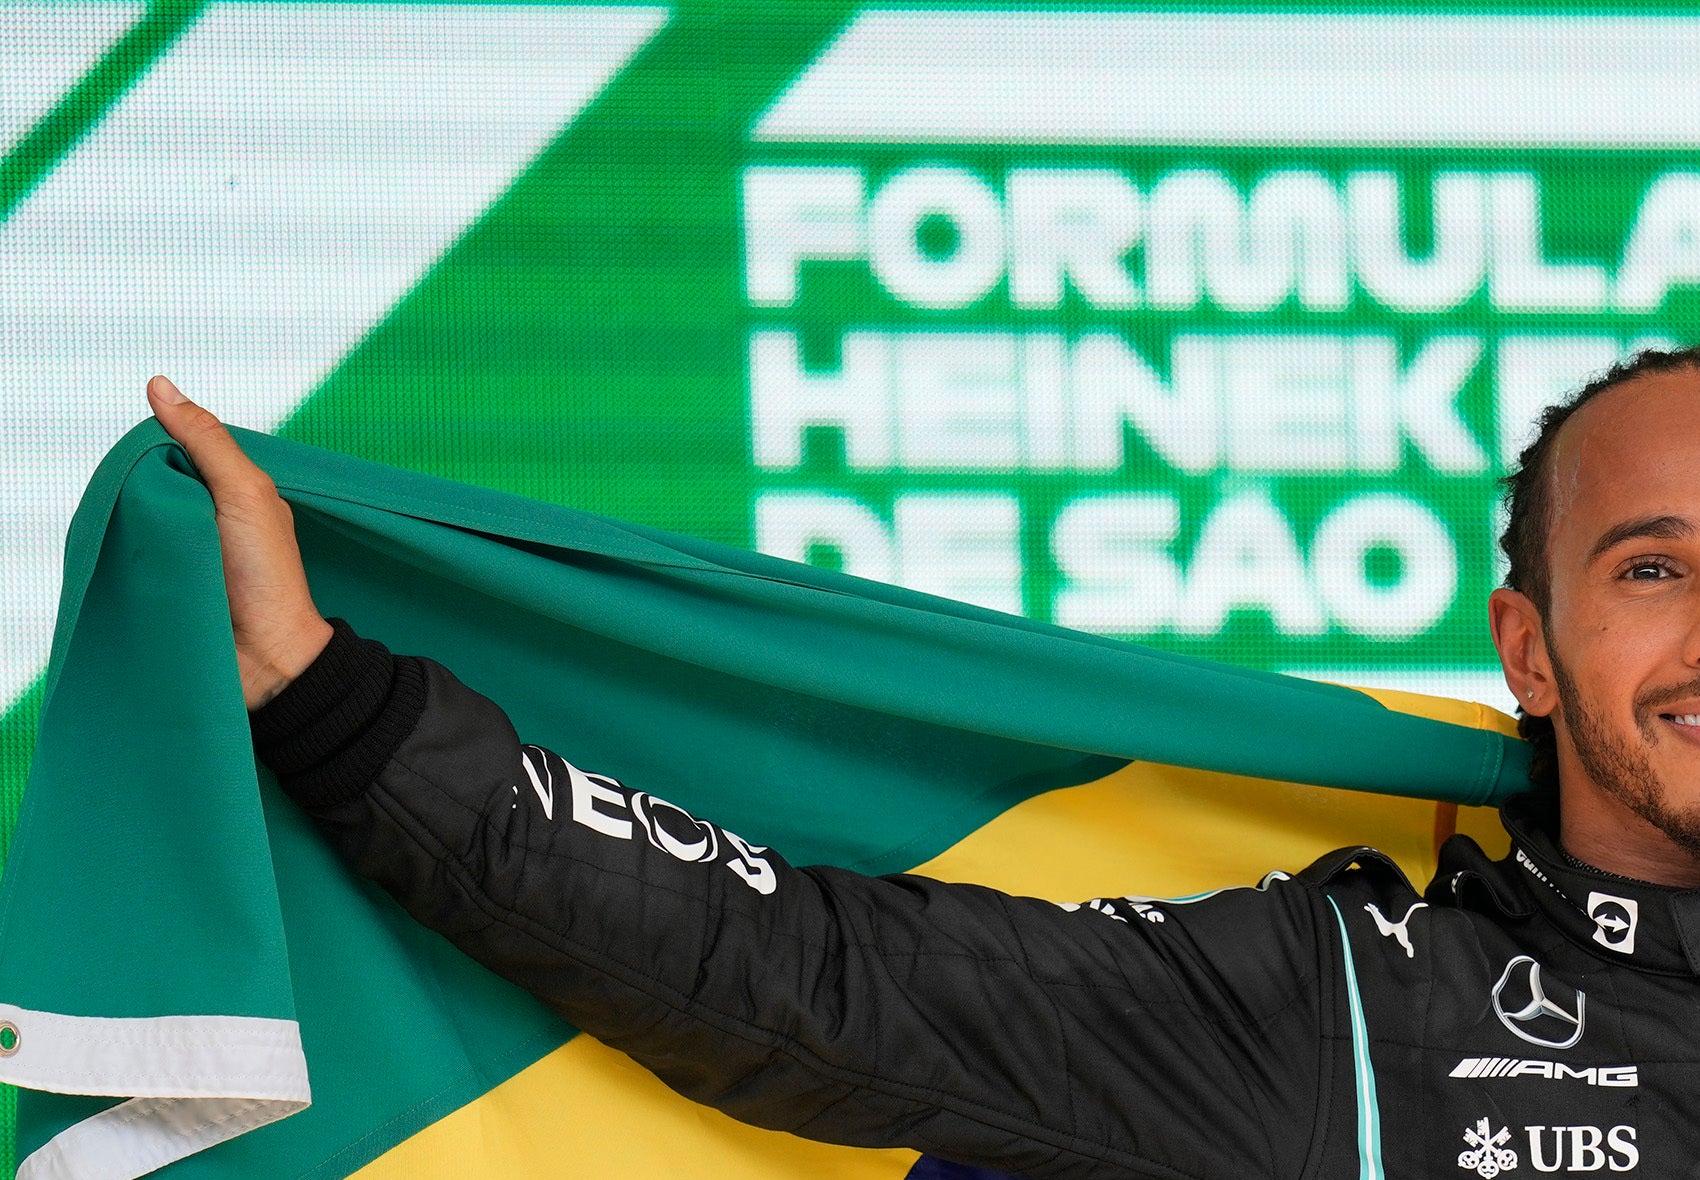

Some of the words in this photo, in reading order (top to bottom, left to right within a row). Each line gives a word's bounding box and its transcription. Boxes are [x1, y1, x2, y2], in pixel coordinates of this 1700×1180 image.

[754, 488, 1022, 622] DE
[1048, 470, 1460, 643] SÃO
[512, 744, 777, 895] NEOS
[1506, 1058, 1639, 1087] AMG
[1524, 1124, 1640, 1173] UBS
